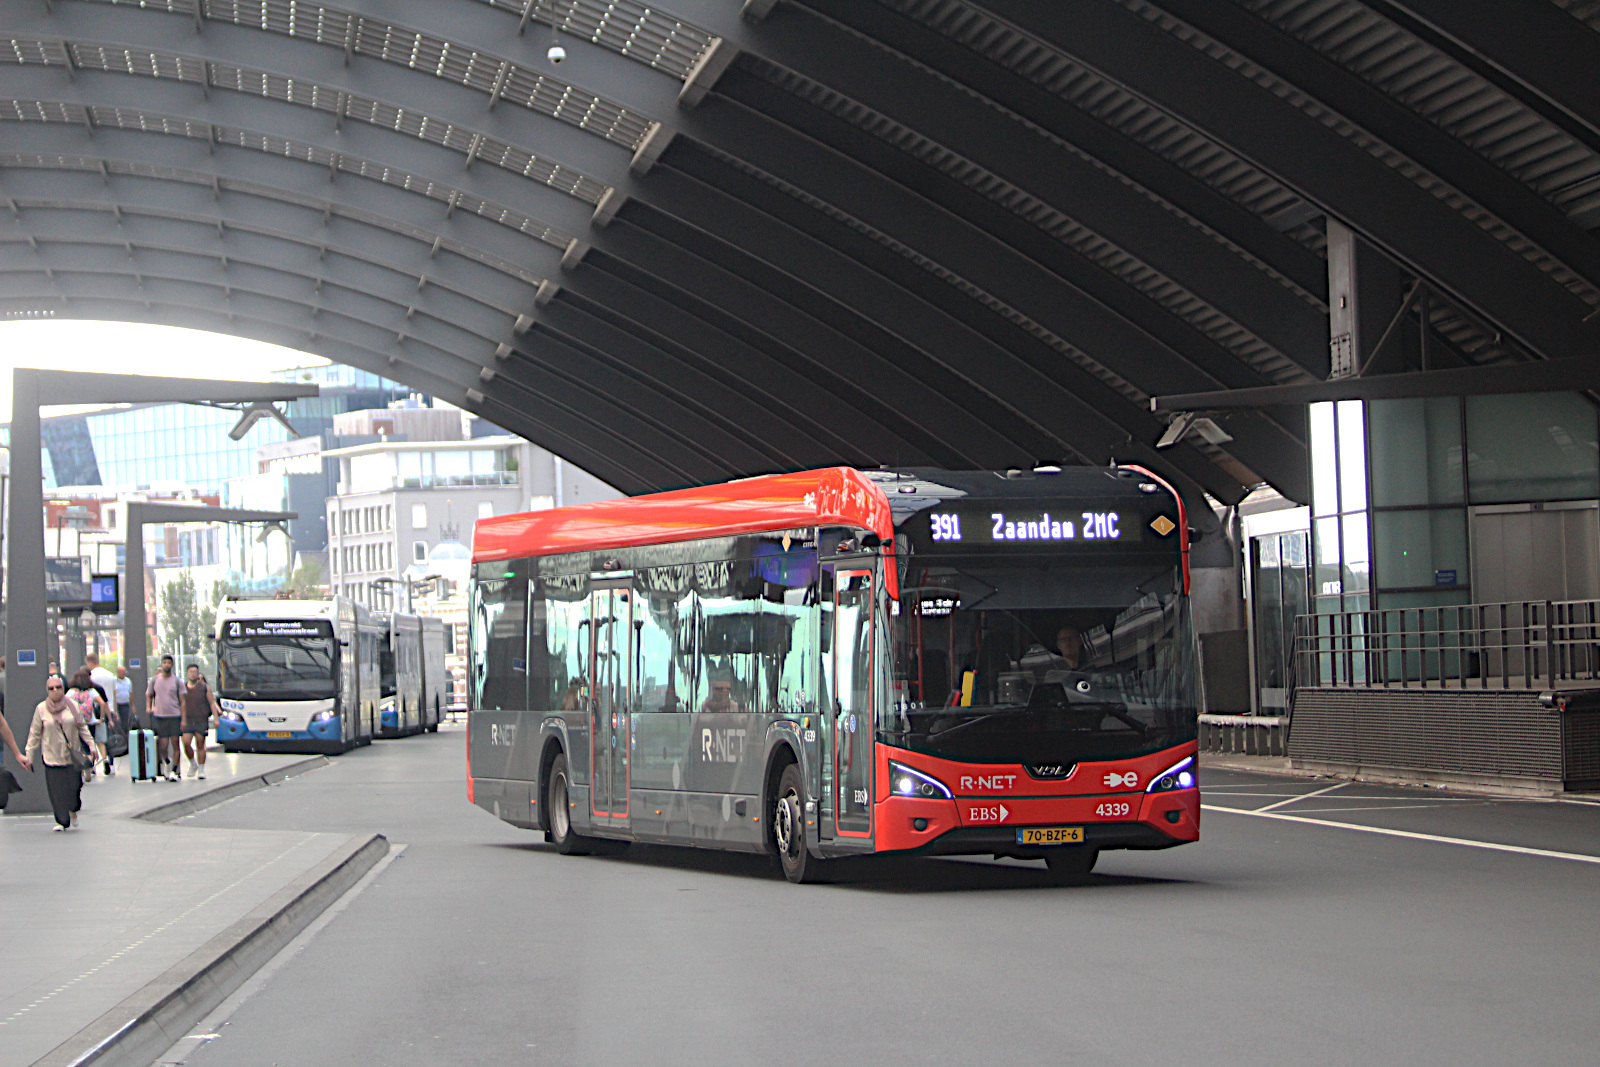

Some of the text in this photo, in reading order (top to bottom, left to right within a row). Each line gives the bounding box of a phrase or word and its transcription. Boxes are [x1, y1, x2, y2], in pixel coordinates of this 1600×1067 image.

[930, 512, 1120, 540] 391 Zaandam ZMC
[103, 585, 113, 596] G
[229, 622, 241, 636] 21
[804, 730, 815, 742] 4339
[1032, 765, 1066, 775] VDL
[854, 790, 864, 803] EBS
[969, 806, 998, 821] EBS
[1095, 803, 1129, 817] 4339
[1027, 829, 1078, 842] 70-BZF-6
